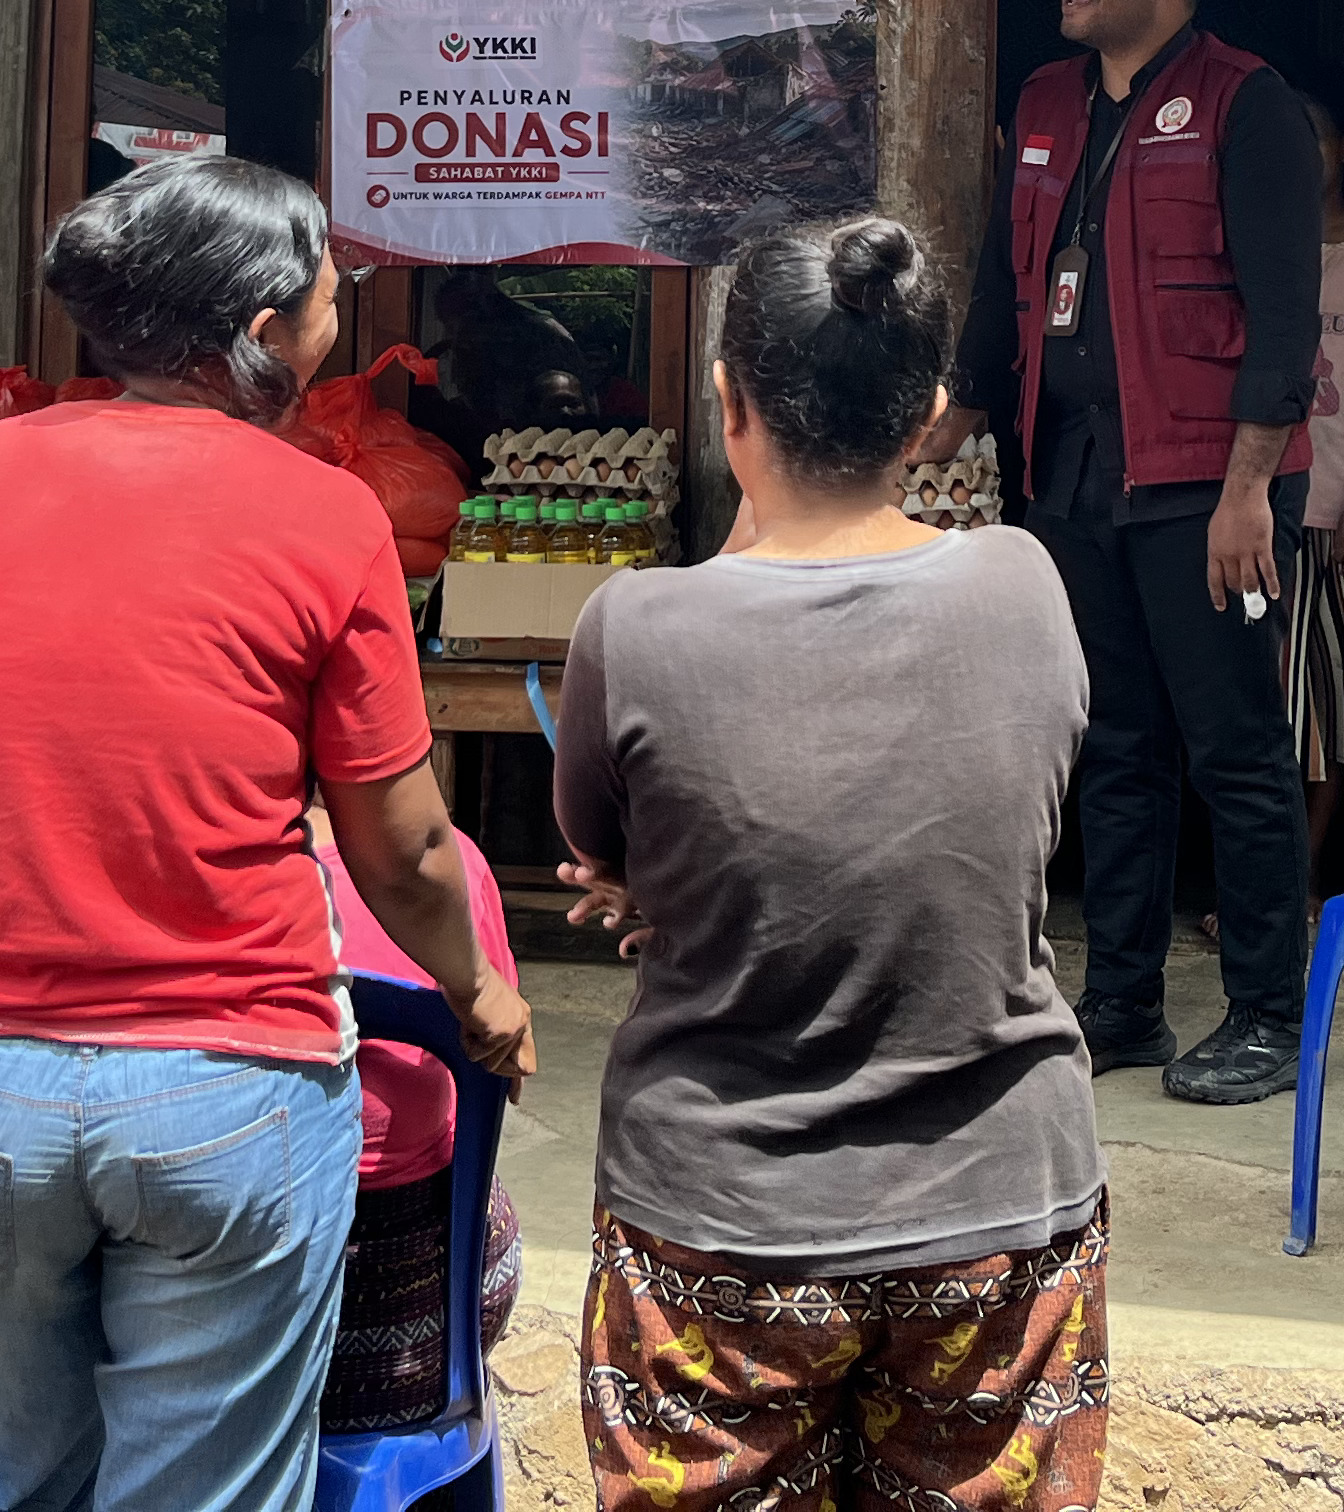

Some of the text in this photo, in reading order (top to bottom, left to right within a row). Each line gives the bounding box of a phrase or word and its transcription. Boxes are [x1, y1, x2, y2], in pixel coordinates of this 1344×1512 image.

[473, 37, 537, 54] YKKI
[400, 89, 571, 106] PENYALURAN
[366, 111, 609, 158] DONASI
[429, 166, 547, 179] SAHABAT YKKI
[393, 191, 606, 201] UNTUK WARGA TERDAMPAK GEMPA NTT
